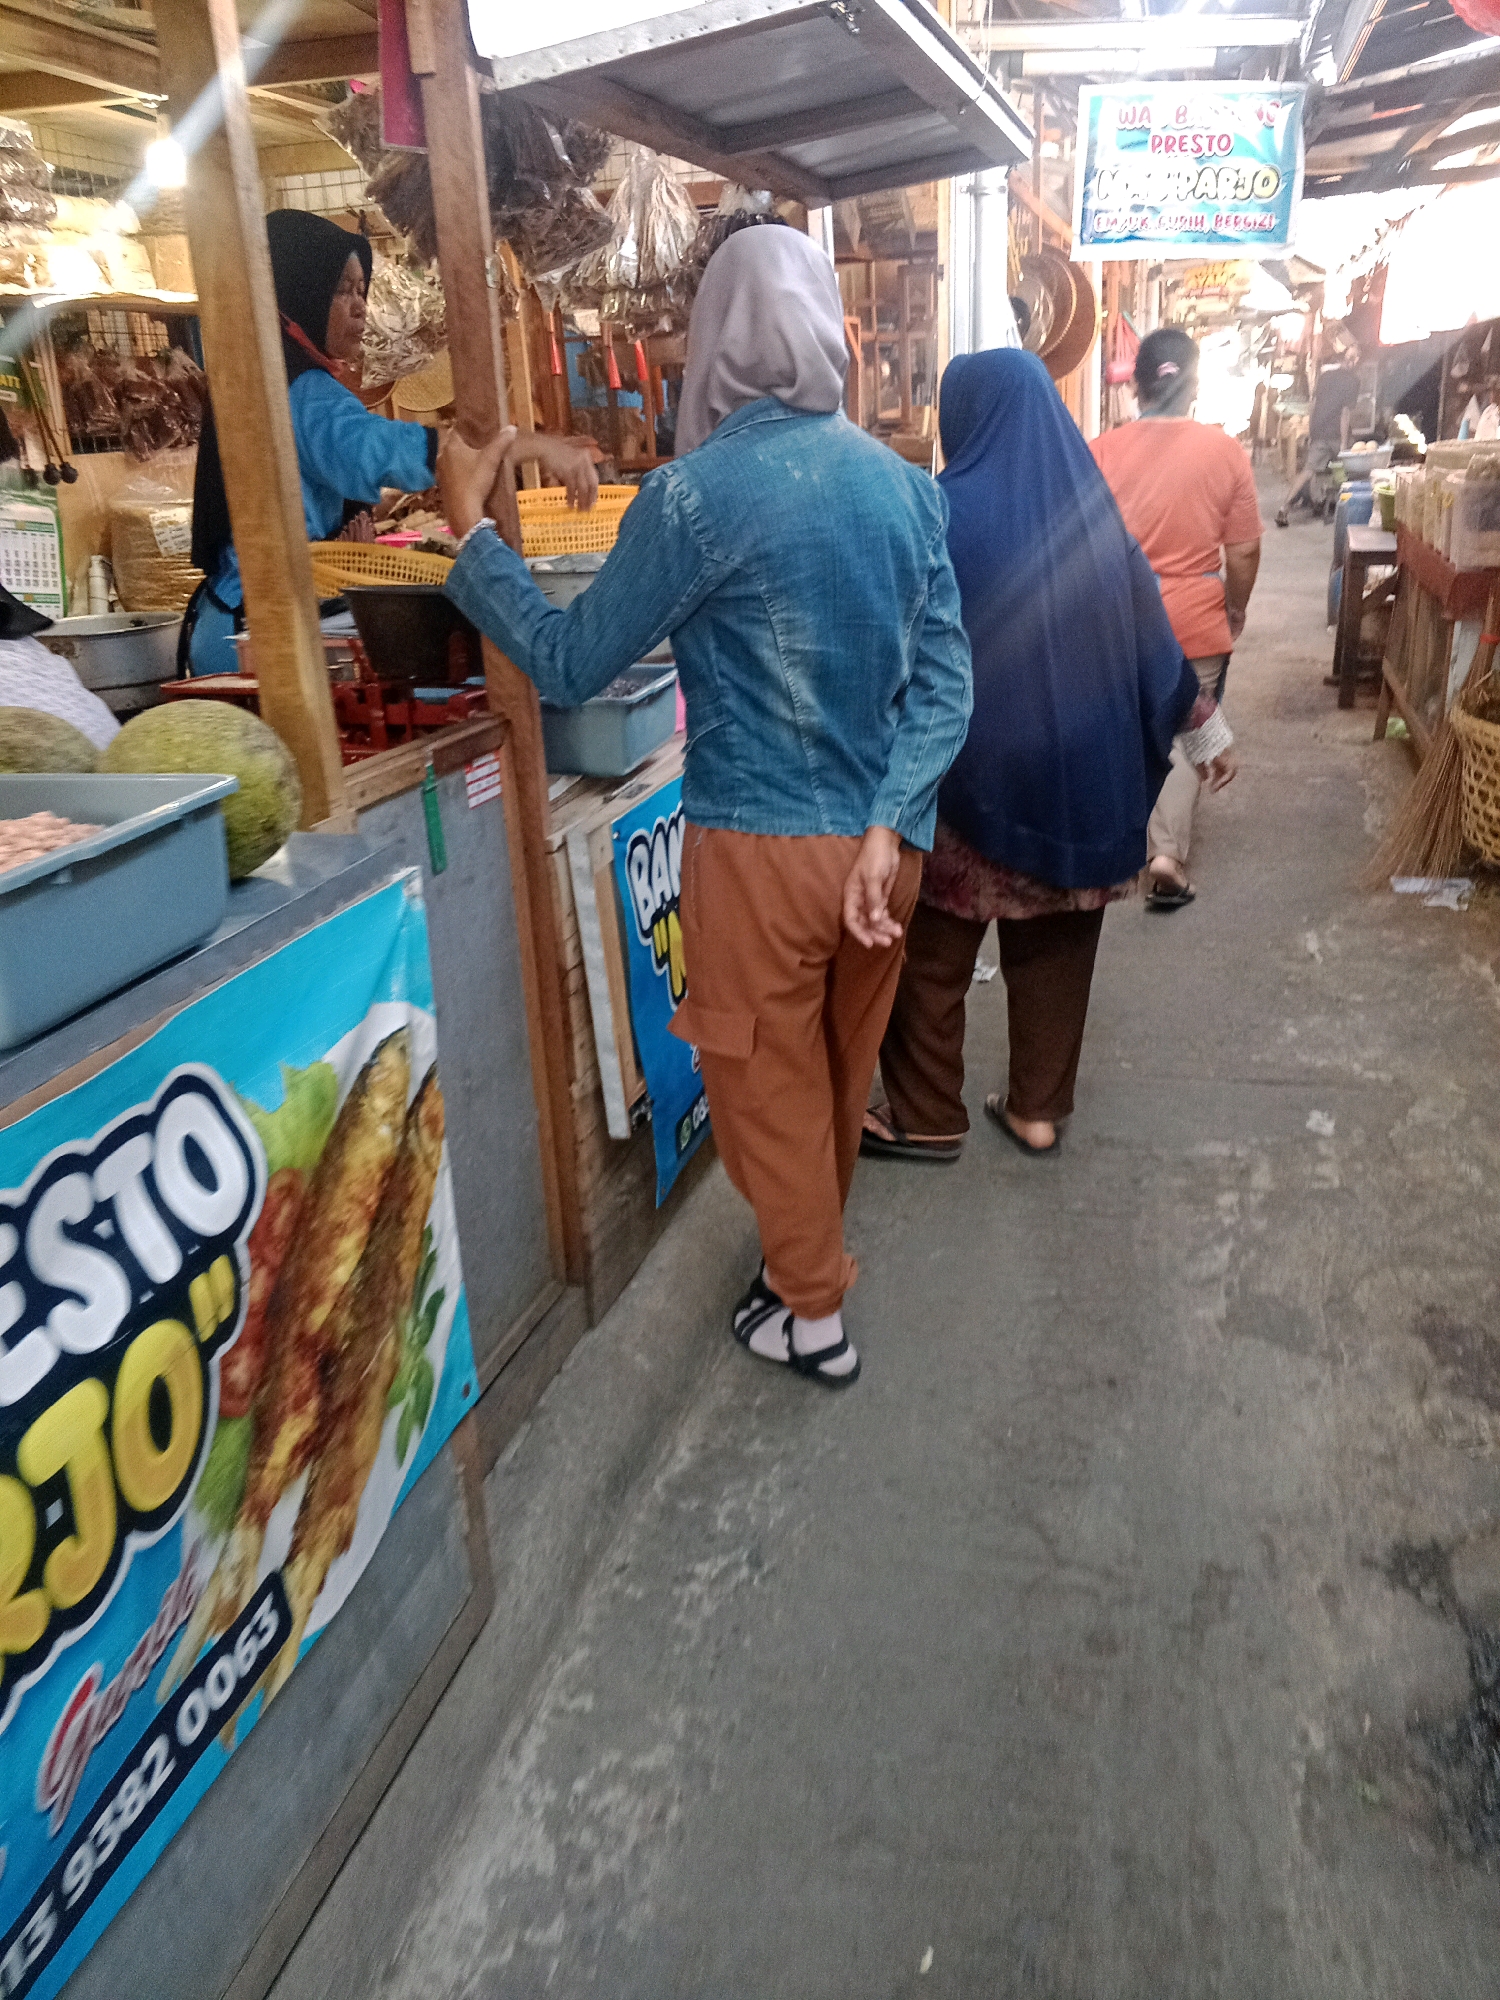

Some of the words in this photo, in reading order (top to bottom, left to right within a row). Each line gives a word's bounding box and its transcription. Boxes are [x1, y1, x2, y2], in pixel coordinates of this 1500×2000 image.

[1151, 133, 1232, 153] PRESTO
[62, 1734, 176, 1912] 9382
[176, 1591, 280, 1747] 0063
